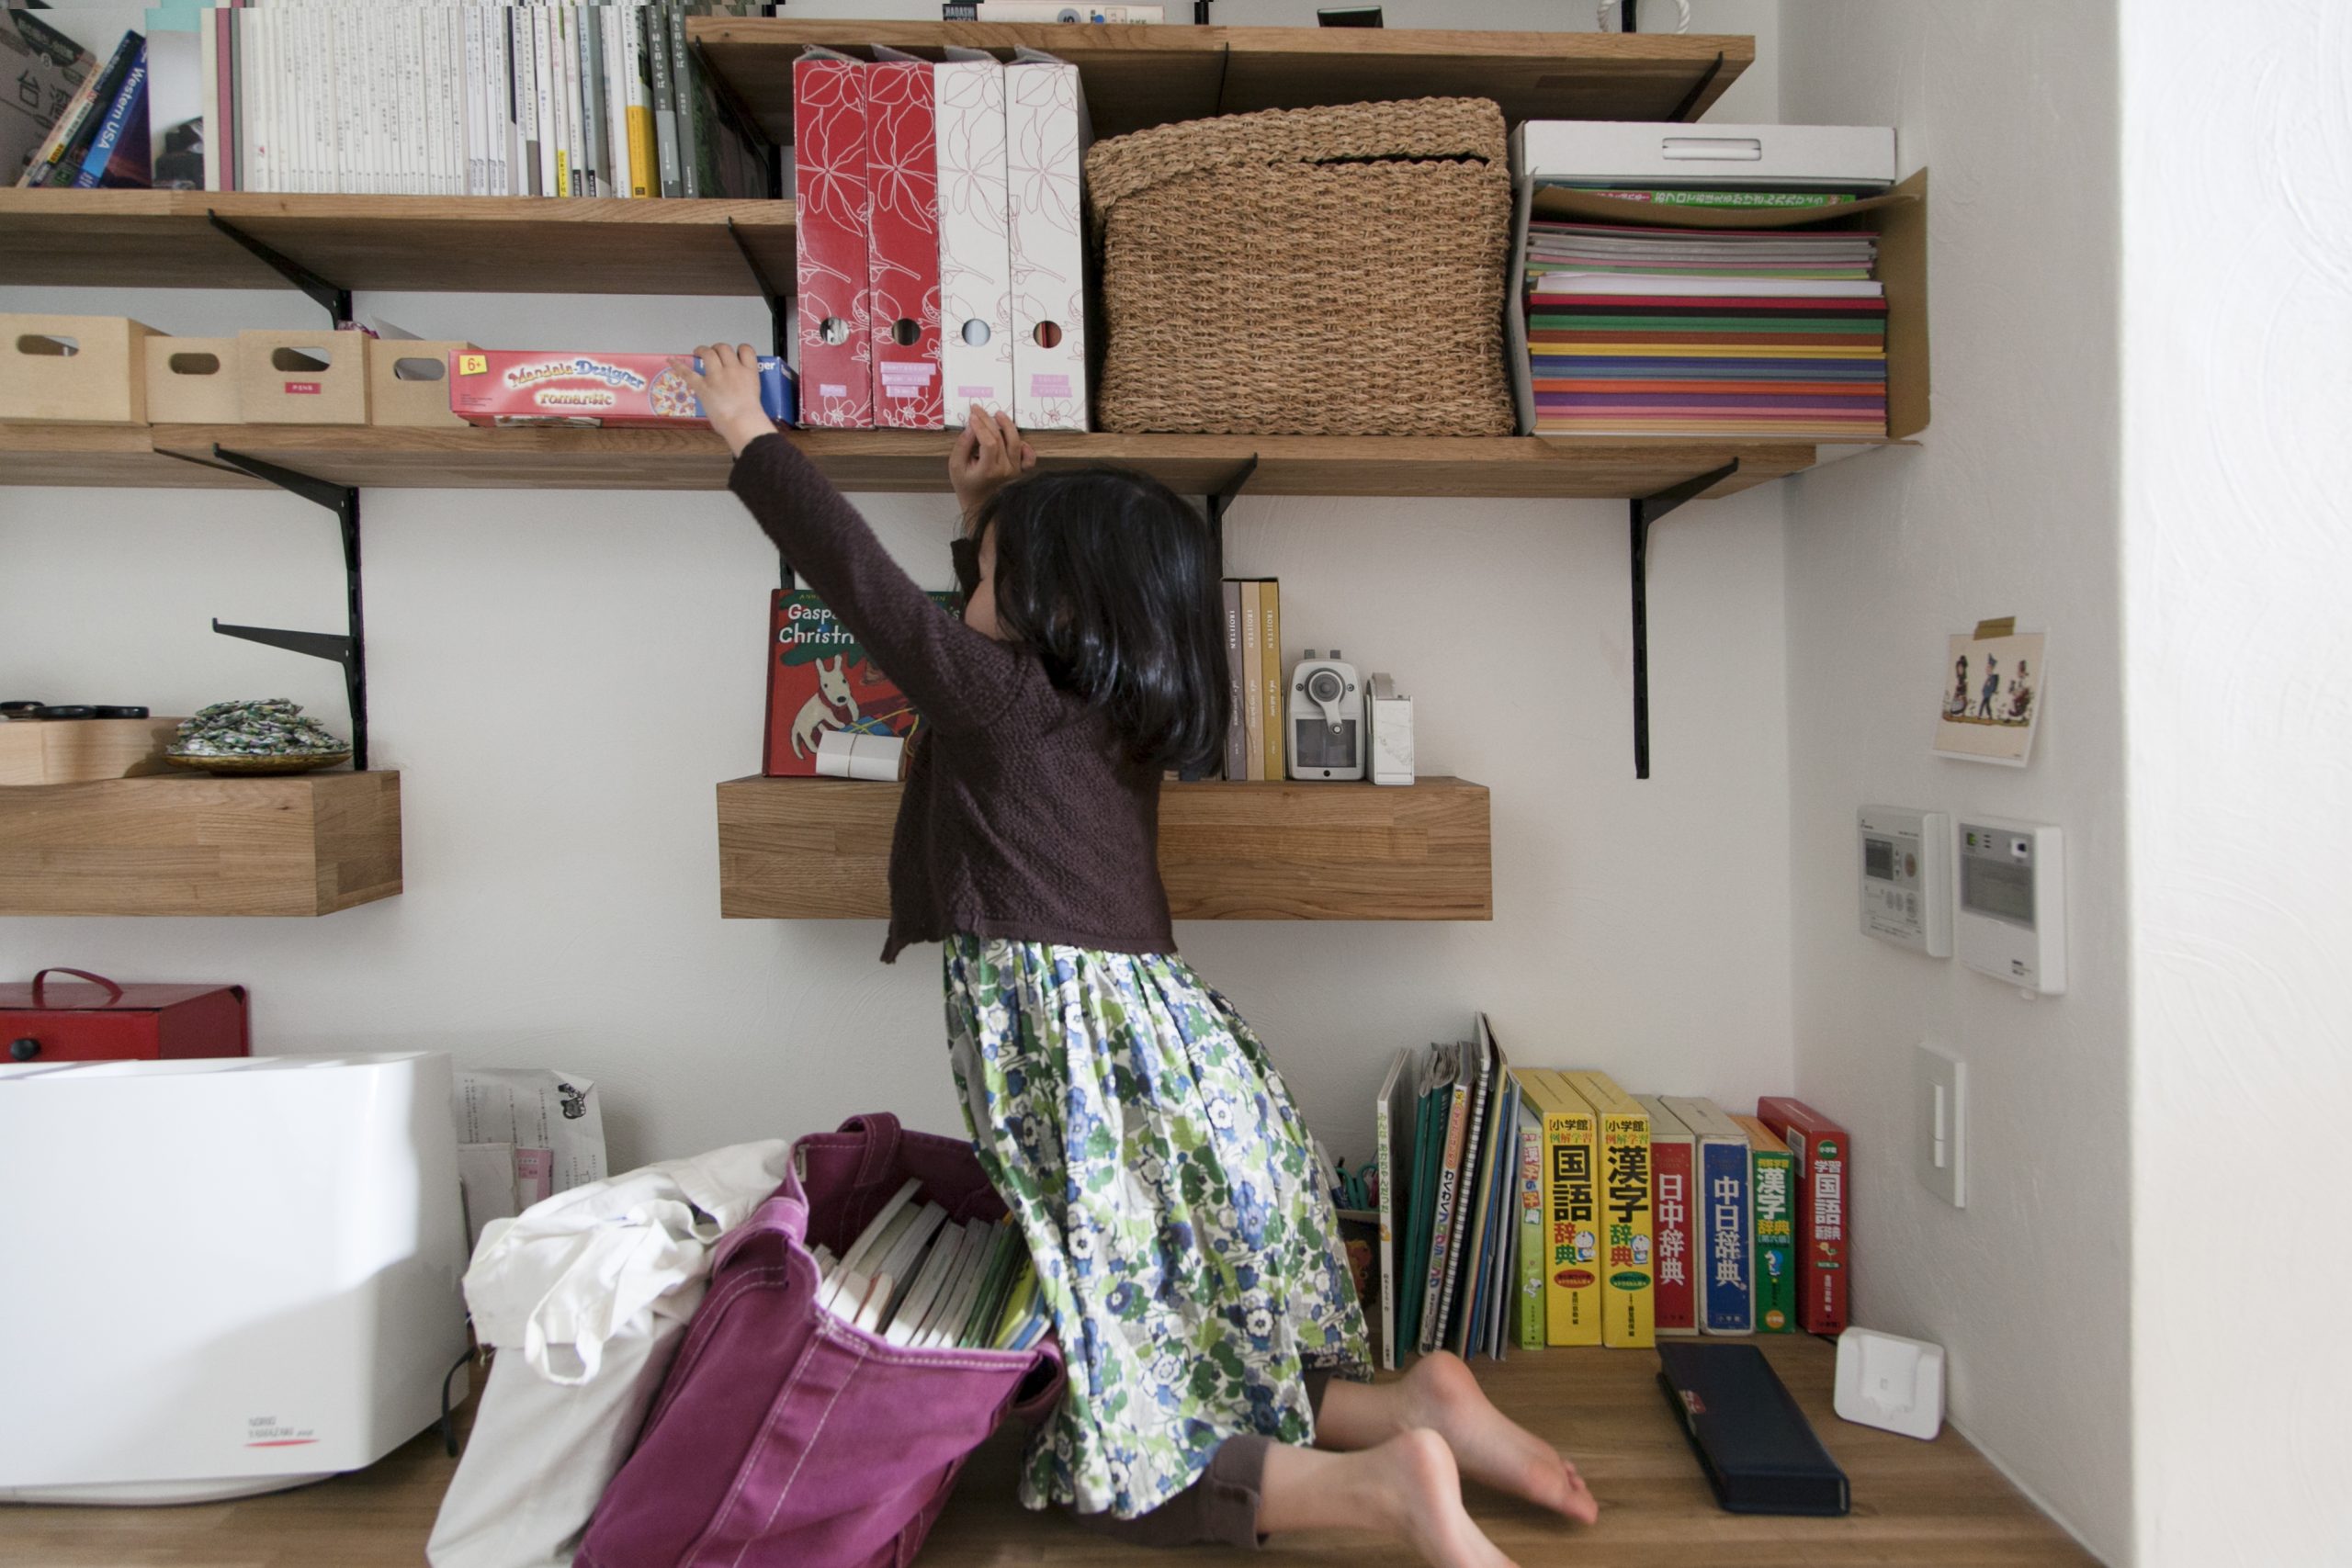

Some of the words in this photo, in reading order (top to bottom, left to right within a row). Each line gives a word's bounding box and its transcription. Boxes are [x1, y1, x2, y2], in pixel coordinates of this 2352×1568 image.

[112, 67, 146, 119] Western
[97, 121, 120, 150] USA
[539, 391, 614, 406] romantic
[1378, 1114, 1387, 1139] みんな
[1550, 1134, 1592, 1143] 例解学習
[1605, 1134, 1648, 1144] 例解学習
[1379, 1143, 1388, 1213] あかちゃんだった
[1815, 1160, 1842, 1173] 学習
[1757, 1168, 1786, 1221] 漢字
[1815, 1173, 1842, 1224] 国語
[1658, 1173, 1686, 1286] 日中辞典
[1713, 1175, 1742, 1287] 中日辞典
[1758, 1220, 1791, 1235] 辞典
